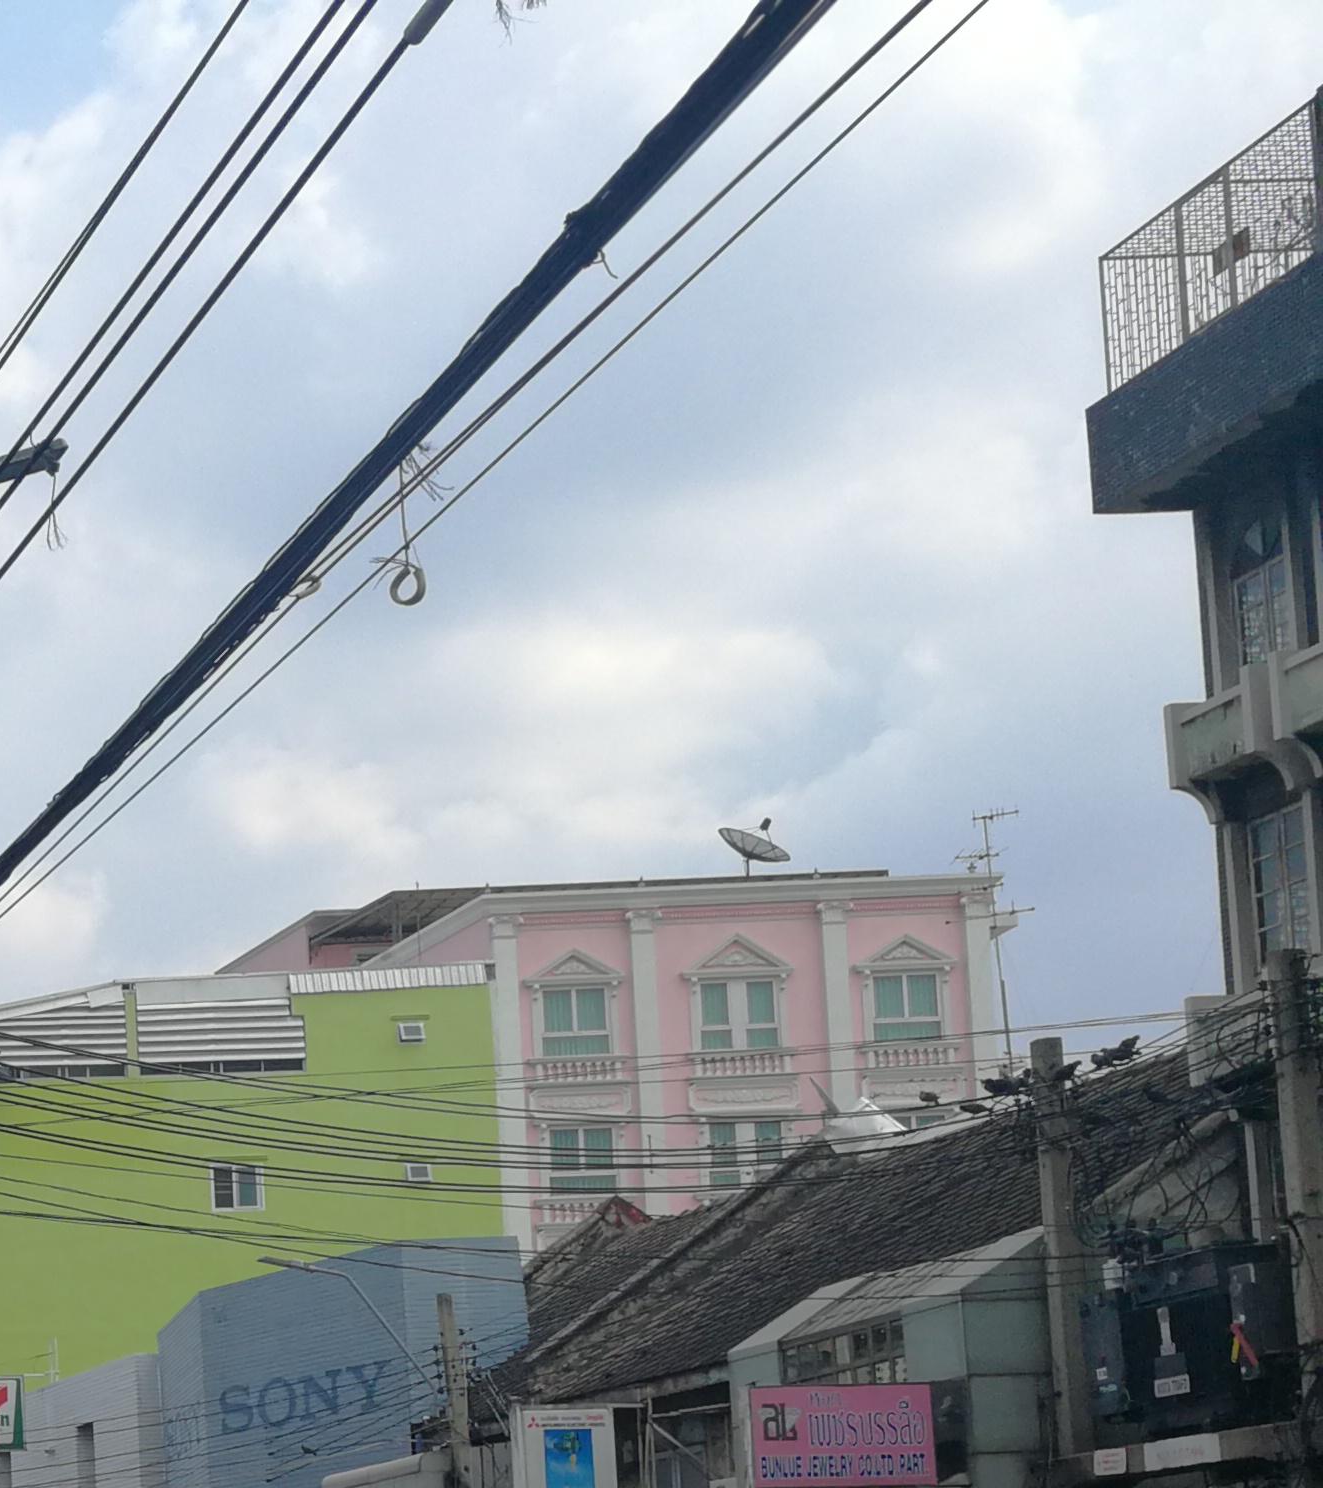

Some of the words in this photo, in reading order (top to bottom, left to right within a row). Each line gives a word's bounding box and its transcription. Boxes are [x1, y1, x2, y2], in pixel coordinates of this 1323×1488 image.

[220, 1355, 389, 1433] SONY
[761, 1456, 802, 1478] BUNLUE
[807, 1455, 853, 1477] JEWELRY
